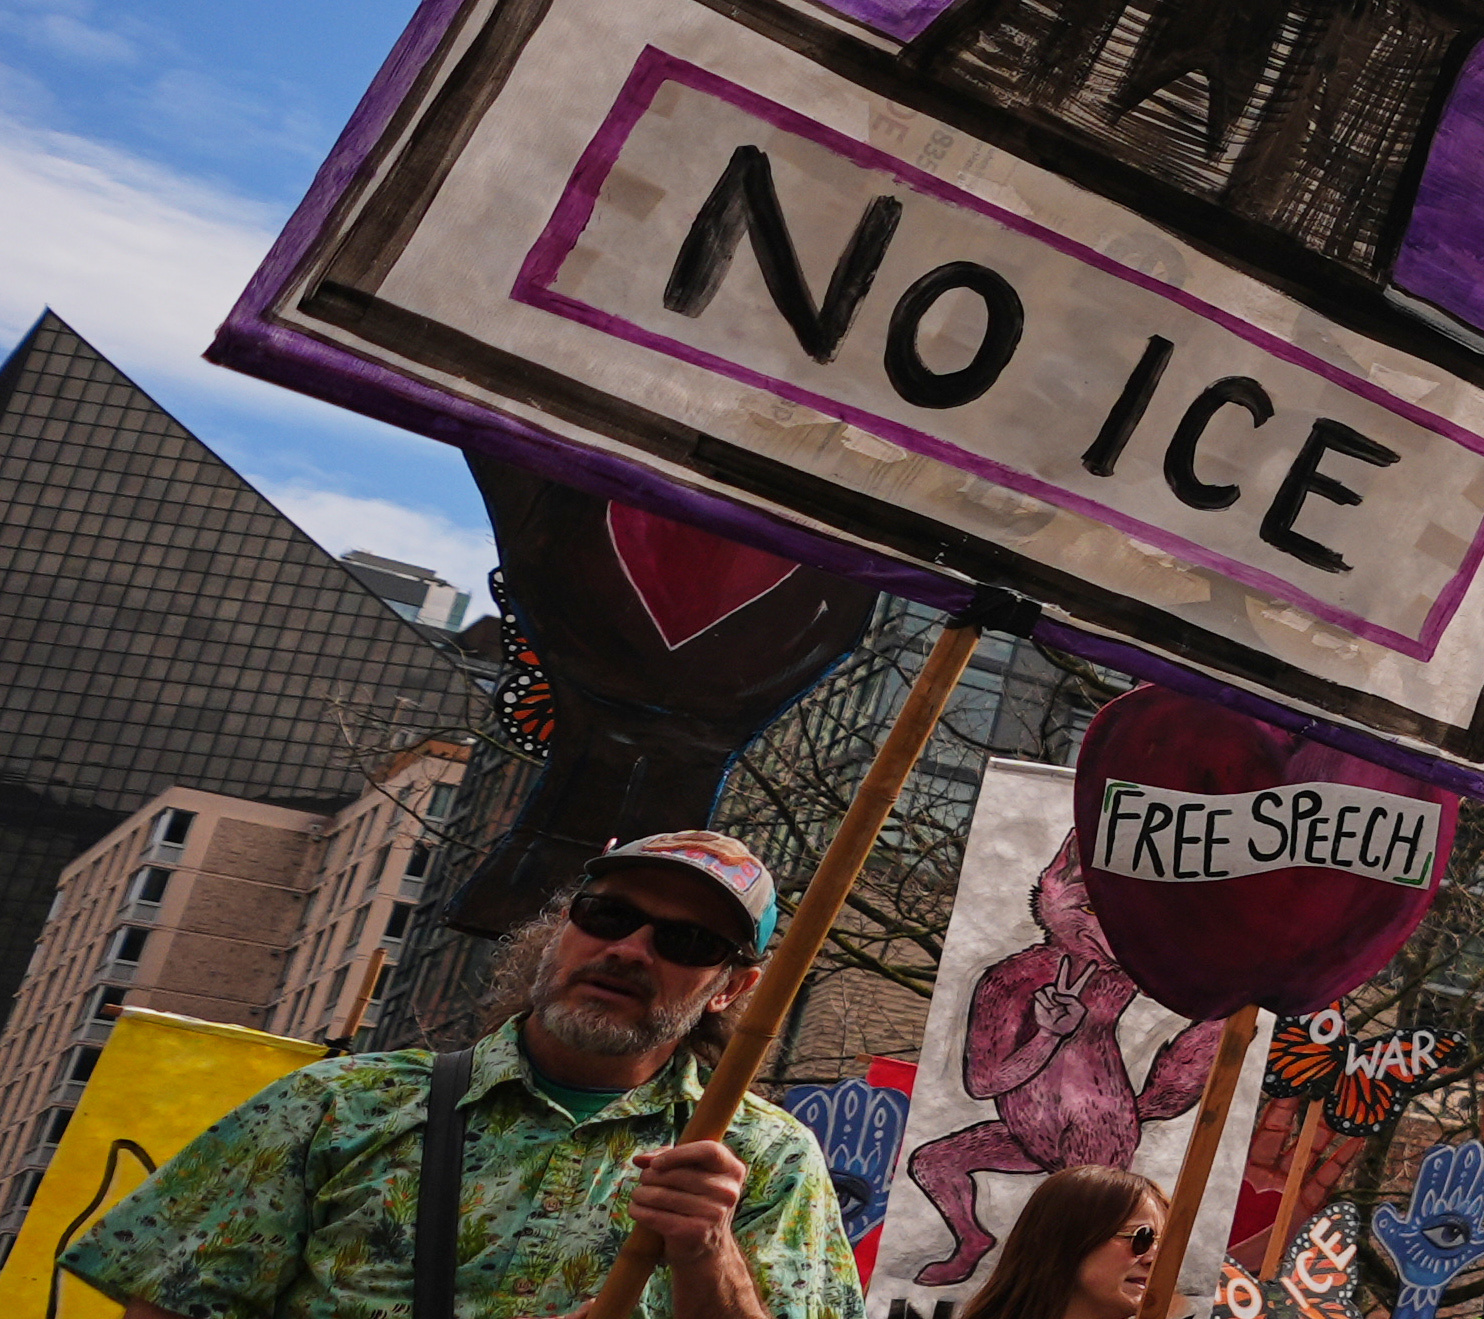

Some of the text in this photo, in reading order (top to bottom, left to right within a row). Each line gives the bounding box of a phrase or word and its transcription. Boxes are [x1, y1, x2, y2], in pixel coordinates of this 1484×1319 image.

[662, 144, 1400, 573] NO ICE
[1103, 787, 1425, 878] FREE SPEECH
[1346, 1031, 1438, 1080] WAR
[1281, 1217, 1356, 1309] ICE
